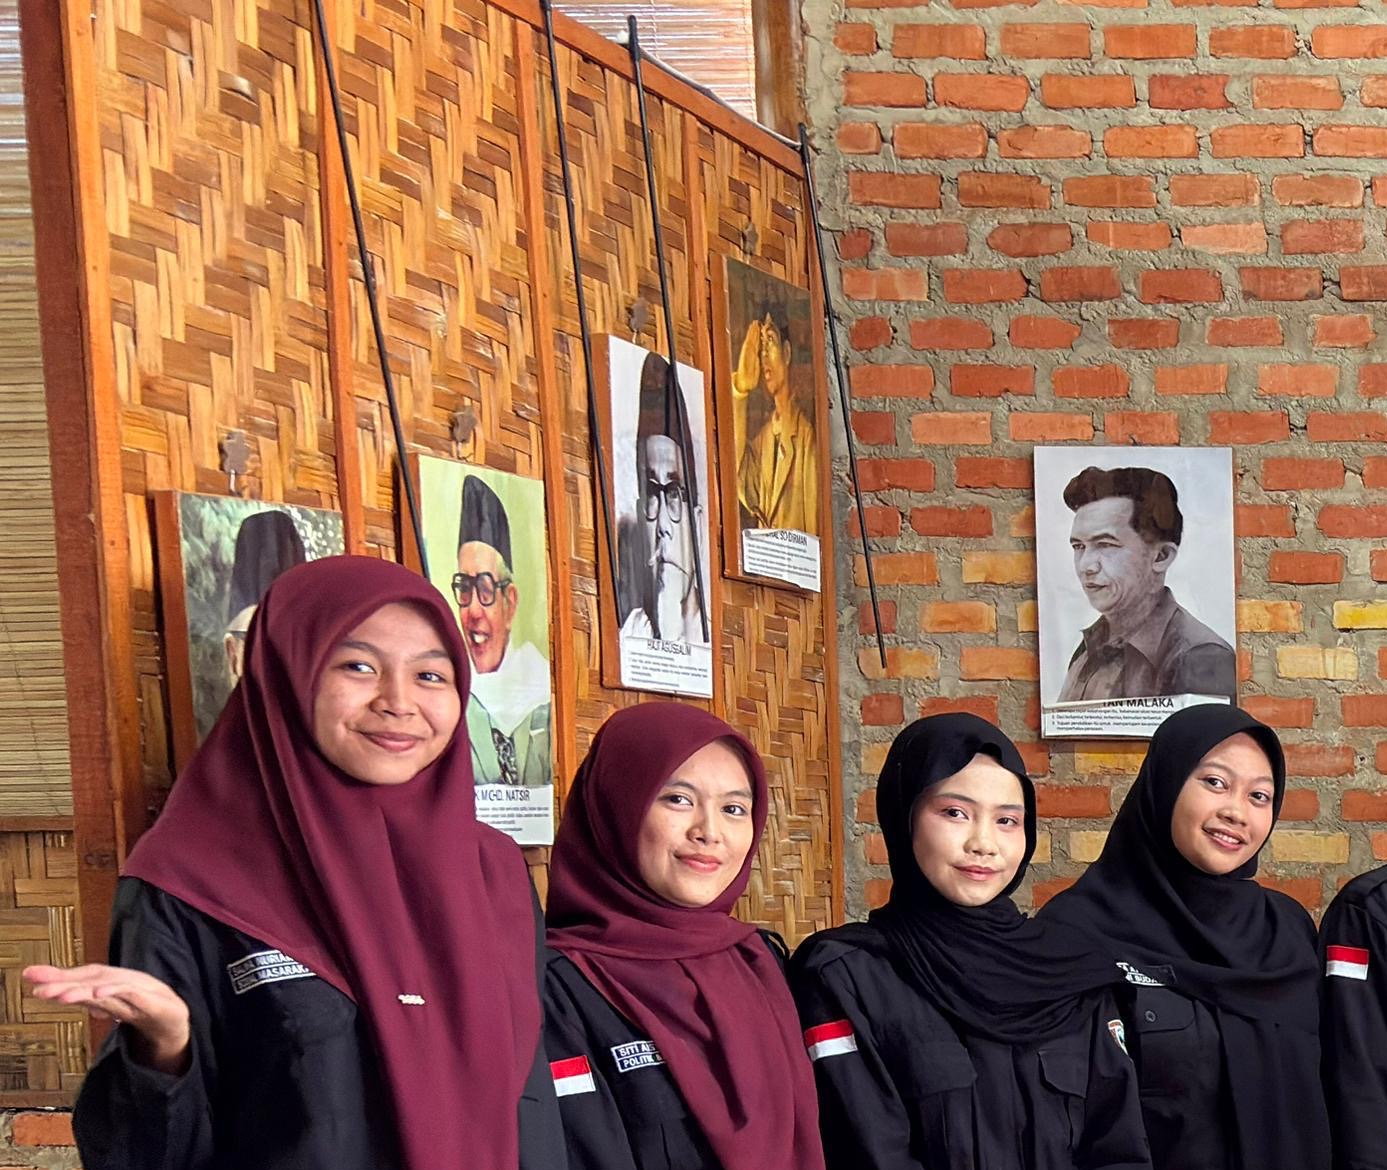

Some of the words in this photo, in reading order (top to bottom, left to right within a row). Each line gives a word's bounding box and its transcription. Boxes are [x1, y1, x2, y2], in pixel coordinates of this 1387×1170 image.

[1103, 698, 1124, 708] TAN
[1126, 697, 1174, 708] MALAKA
[506, 789, 530, 801] NATSIR
[618, 1045, 640, 1057] SITI
